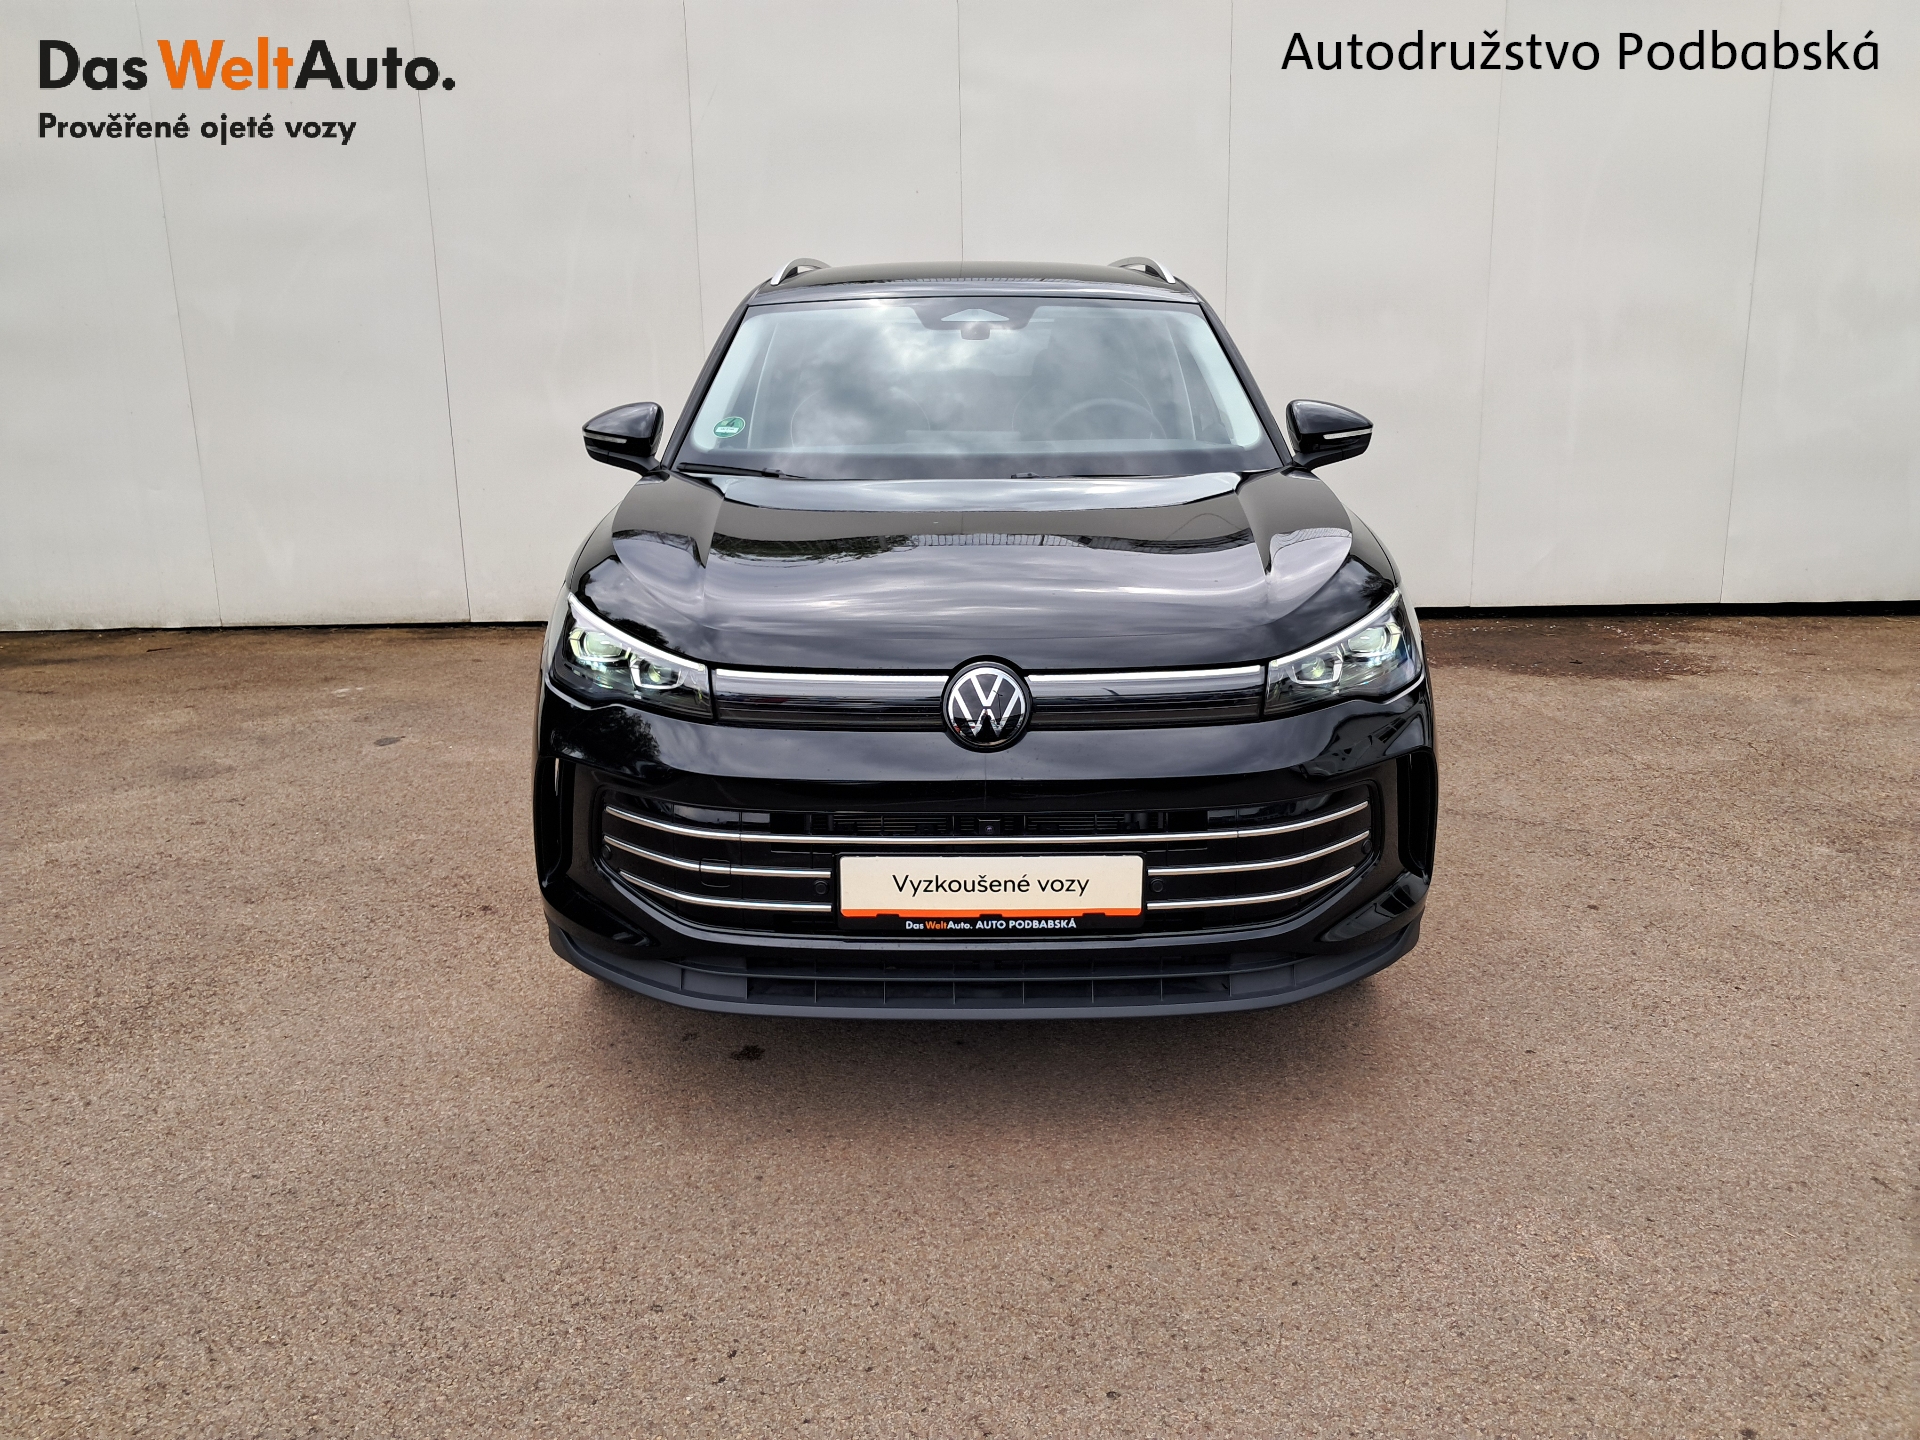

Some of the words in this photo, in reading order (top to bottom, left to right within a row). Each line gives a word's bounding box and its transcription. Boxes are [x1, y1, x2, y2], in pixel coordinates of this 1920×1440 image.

[892, 873, 1031, 897] Vyzkoušené
[1037, 878, 1090, 897] vozy
[905, 920, 924, 930] Das
[975, 920, 1006, 930] AUTO
[1008, 917, 1077, 930] PODBABSKÁ
